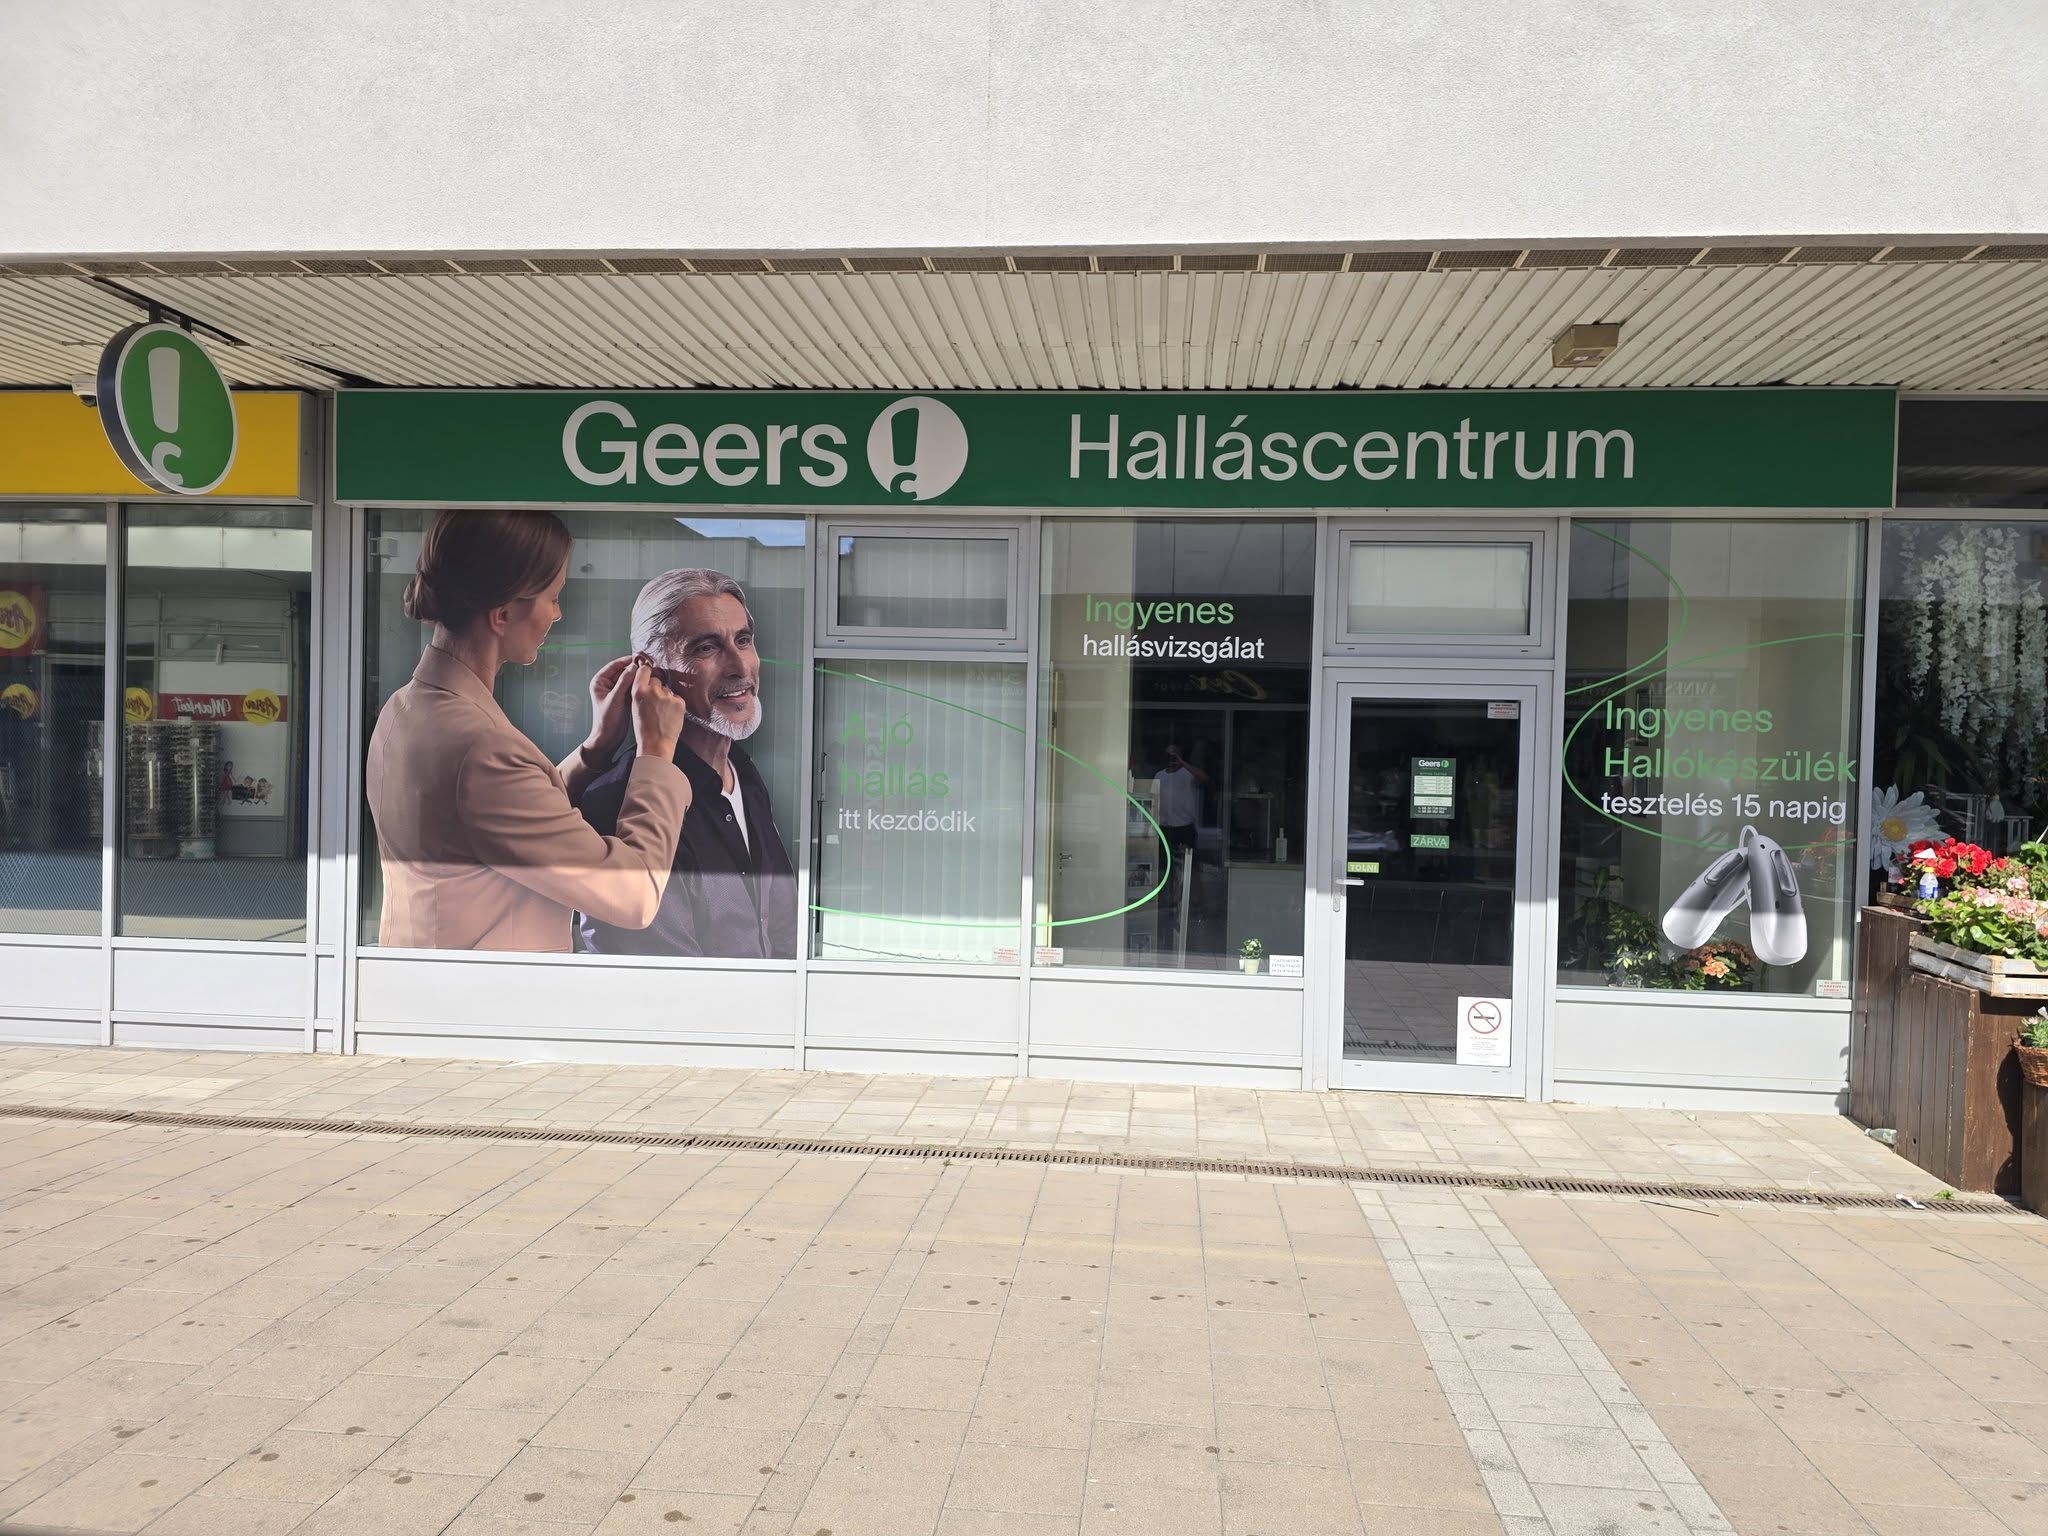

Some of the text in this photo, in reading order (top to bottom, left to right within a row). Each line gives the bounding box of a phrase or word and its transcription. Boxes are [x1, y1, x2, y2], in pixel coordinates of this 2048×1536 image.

[562, 400, 848, 488] Geers
[1069, 413, 1635, 482] Halláscentrum
[1085, 595, 1234, 630] Ingyenes
[1083, 634, 1265, 664] hallásvizsgálat
[839, 712, 914, 754] A jó
[1606, 700, 1773, 738] Ingyenes
[839, 761, 949, 797] hallás
[1604, 747, 1857, 783] Hallókészülék
[838, 808, 976, 832] itt kezdődik
[1601, 792, 1846, 825] tesztelés 15 napig
[1413, 835, 1447, 847] ZÁRVA
